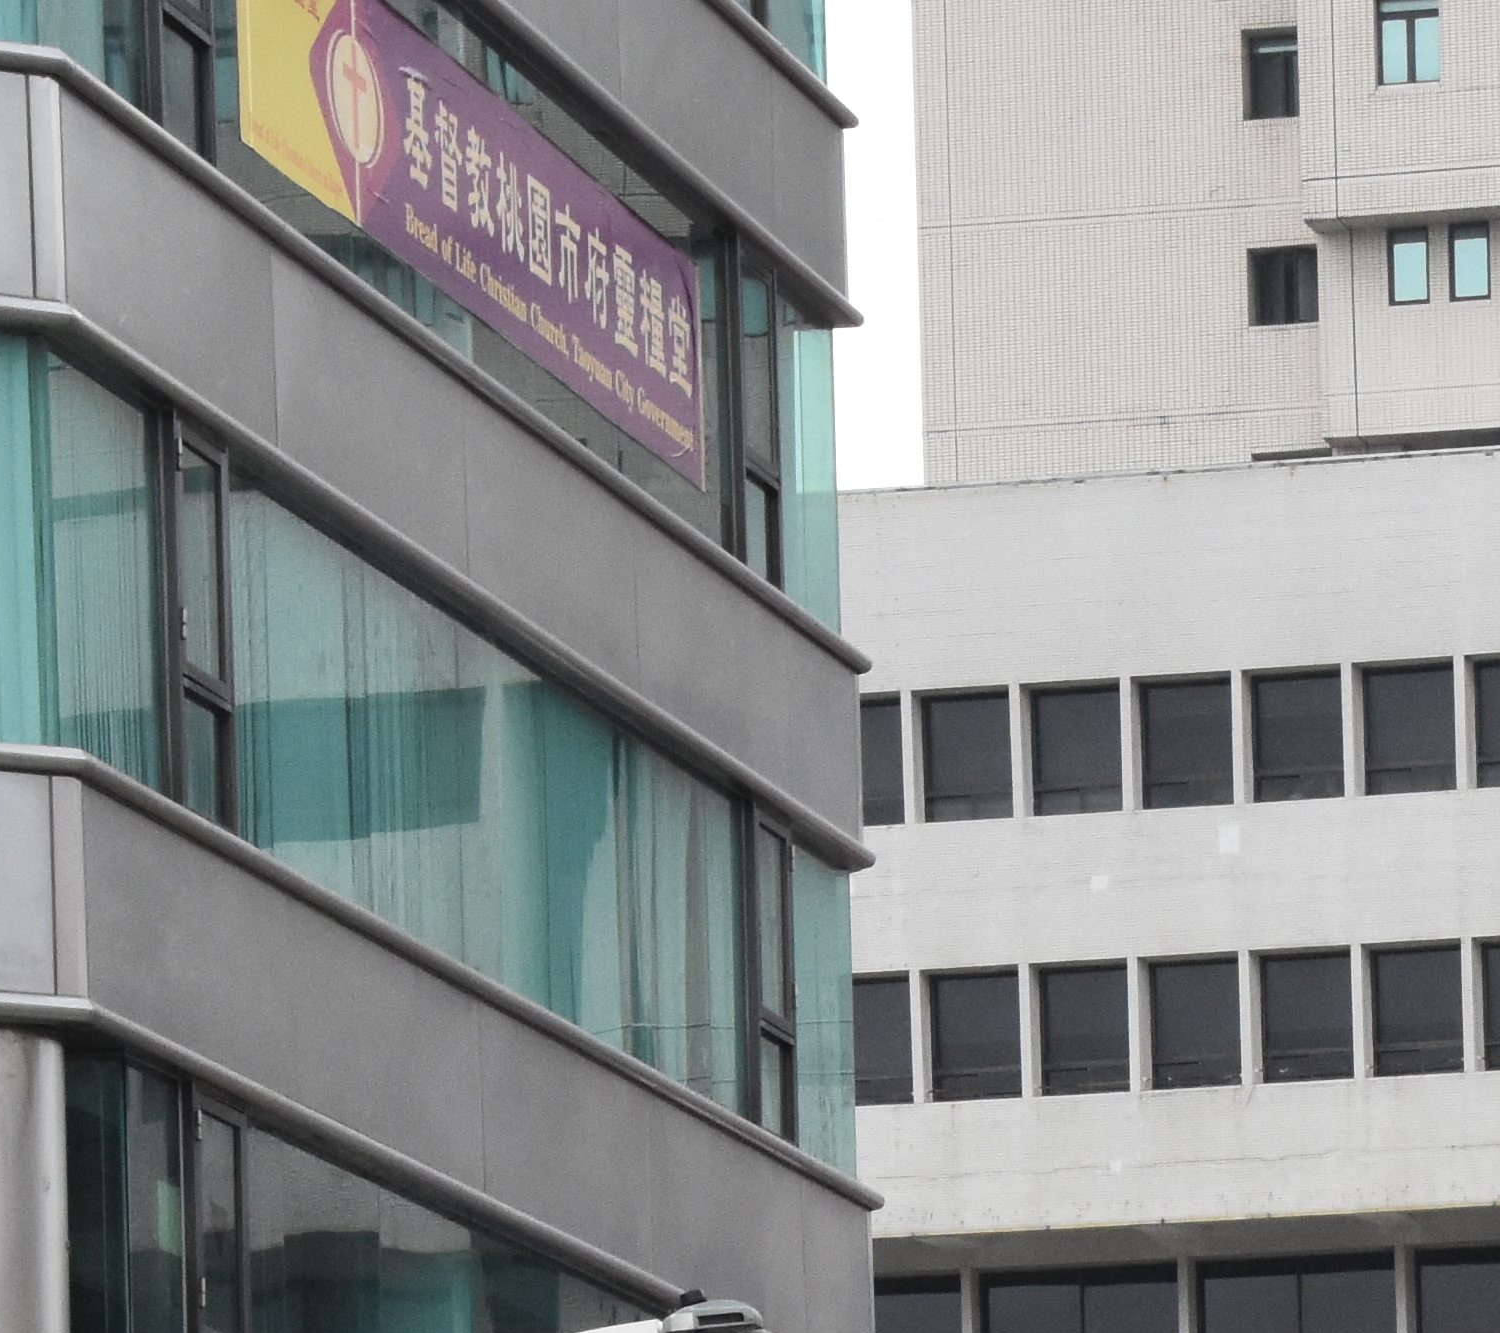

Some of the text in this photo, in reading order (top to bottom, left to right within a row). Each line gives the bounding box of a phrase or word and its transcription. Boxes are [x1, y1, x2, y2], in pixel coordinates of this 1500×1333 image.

[405, 203, 439, 254] Bread
[441, 235, 453, 265] of
[455, 241, 477, 284] Life
[479, 262, 528, 323] Christian
[571, 333, 613, 391] Taoyuan
[615, 369, 635, 413] City
[637, 386, 695, 452] Government
